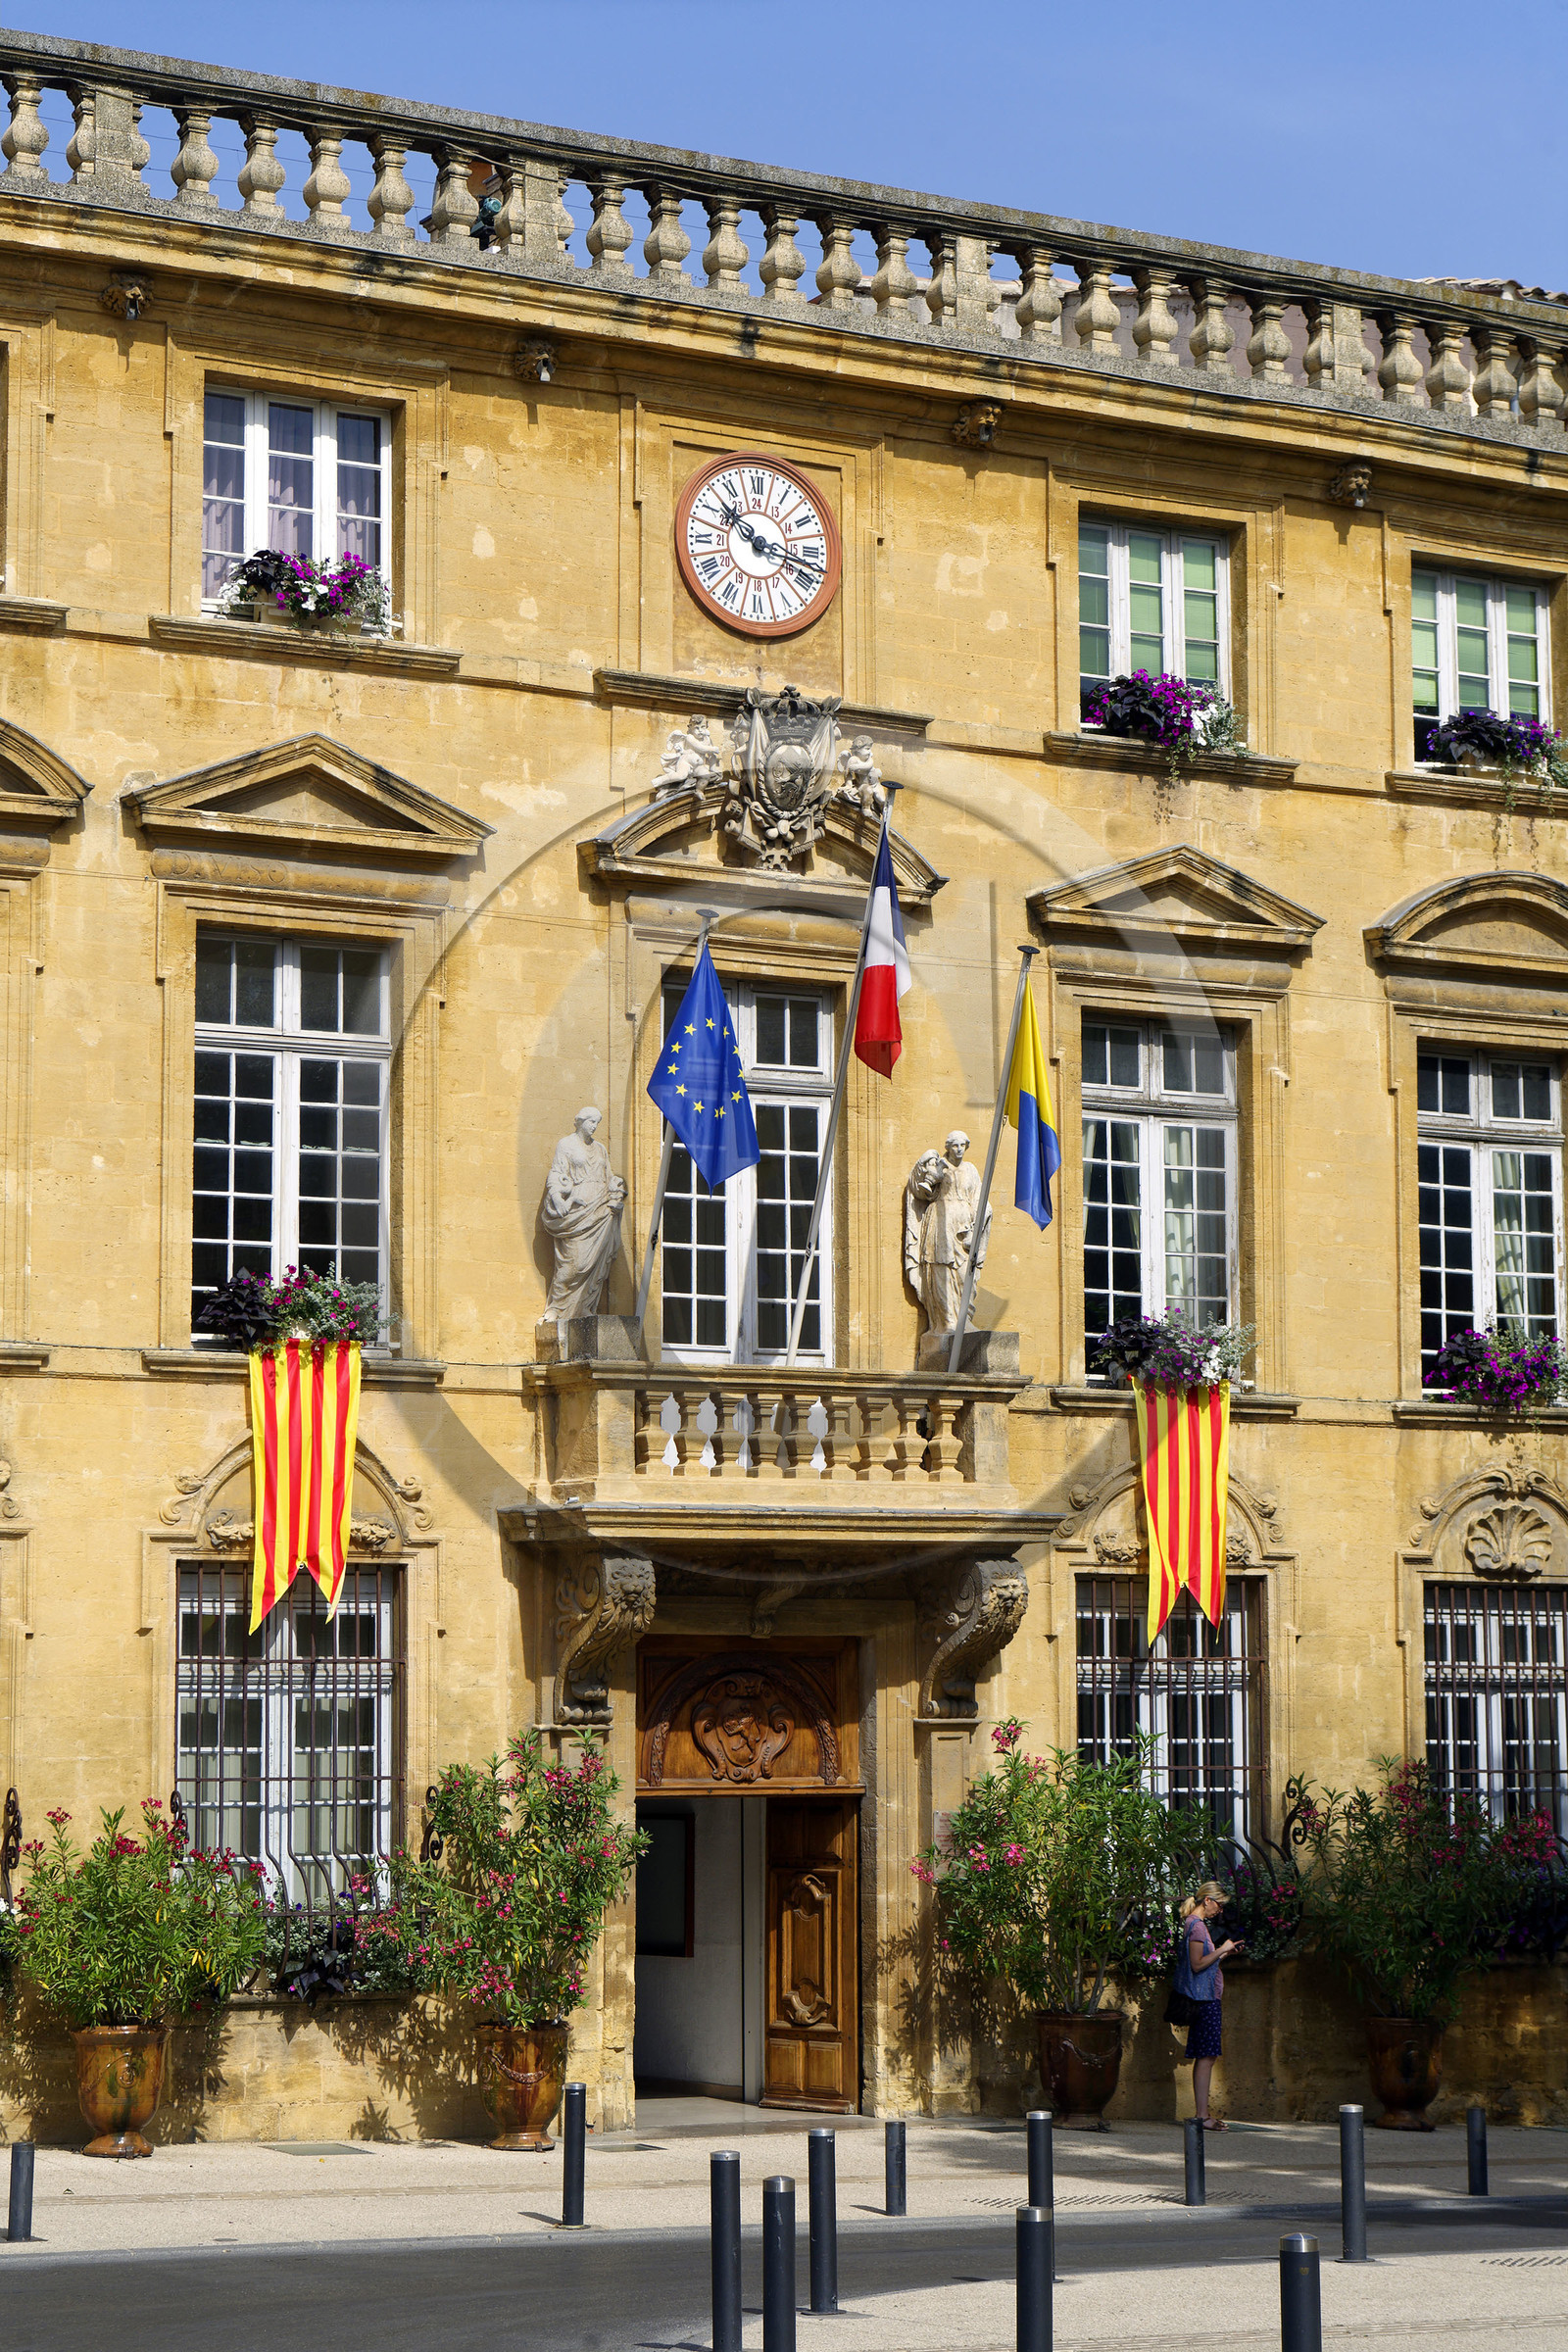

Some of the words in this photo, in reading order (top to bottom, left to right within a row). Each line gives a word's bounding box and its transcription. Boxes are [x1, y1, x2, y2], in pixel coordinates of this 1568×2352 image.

[749, 475, 764, 496] XII
[752, 498, 762, 510] 24
[771, 506, 780, 518] 13
[784, 522, 792, 534] 14
[794, 514, 812, 529] II
[716, 534, 725, 547] 21
[790, 544, 799, 557] 15
[803, 545, 819, 560] III
[719, 555, 731, 567] 20
[785, 563, 794, 575] 16
[735, 571, 744, 584] 19
[772, 576, 780, 589] 17
[754, 579, 762, 592] 18
[721, 580, 739, 605] VII
[752, 594, 764, 614] VI
